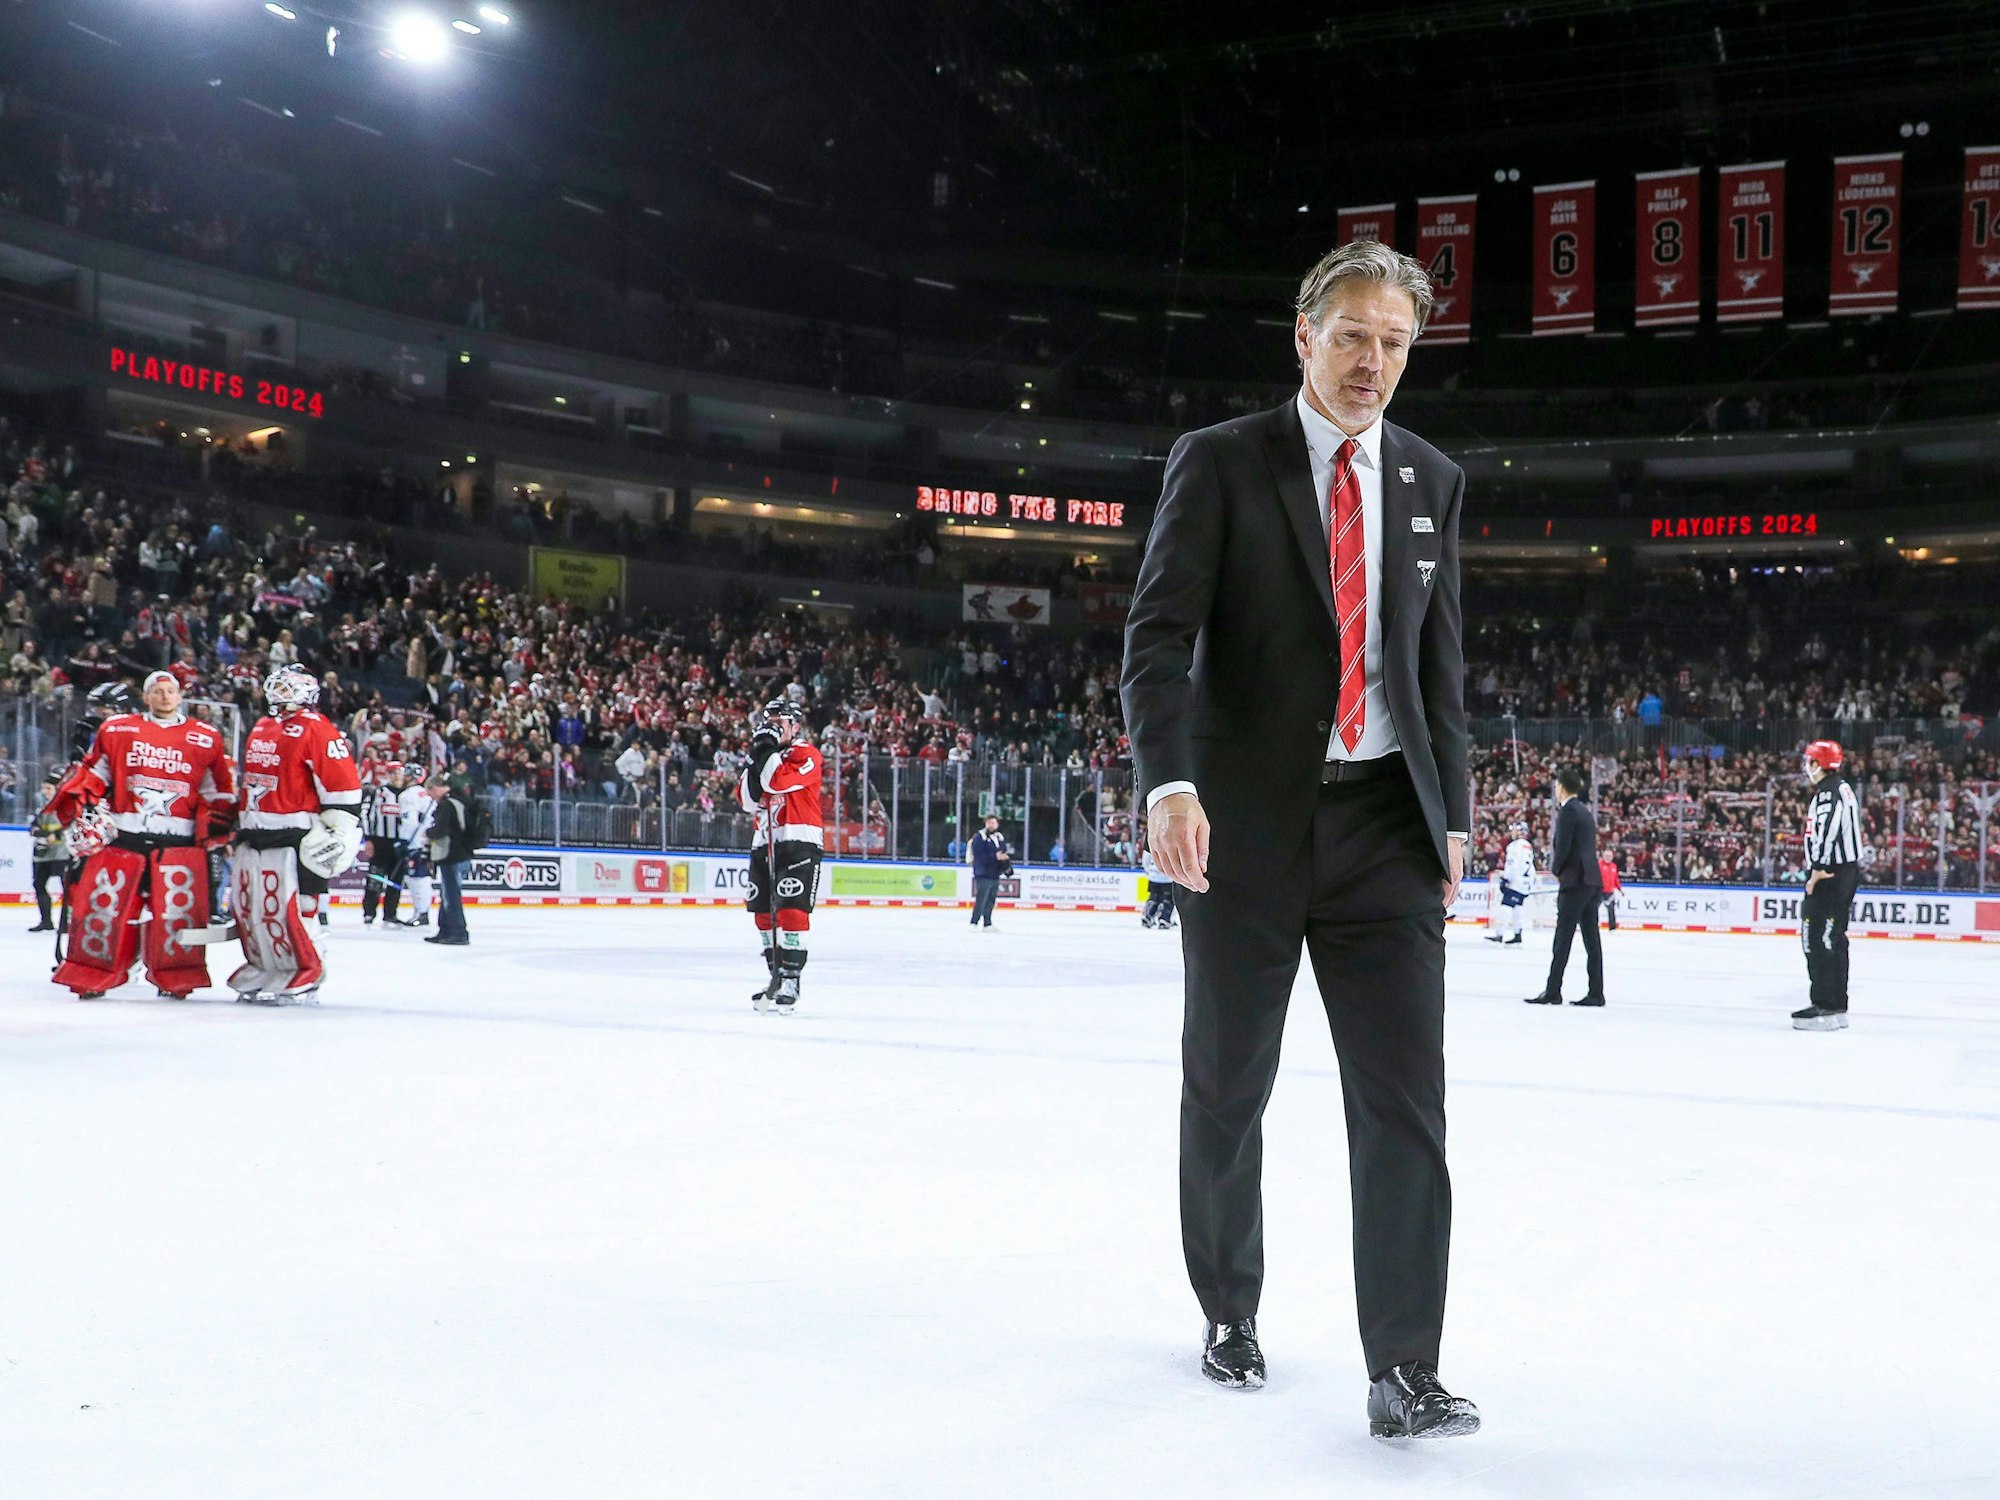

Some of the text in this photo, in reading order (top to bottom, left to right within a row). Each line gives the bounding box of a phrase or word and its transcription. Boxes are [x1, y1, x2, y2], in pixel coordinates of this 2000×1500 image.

[1652, 218, 1683, 265] 8
[1729, 211, 1774, 262] 11
[1840, 204, 1893, 255] 12
[1429, 243, 1457, 289] 4
[1551, 231, 1578, 278] 6
[110, 348, 324, 418] PLAYOFFS 2024
[916, 486, 1125, 527] BRING THE FIRE
[1651, 513, 1818, 538] PLAYOFFS 2024
[132, 741, 183, 761] Rhein
[327, 738, 350, 760] 45
[126, 752, 192, 774] Energie
[465, 862, 558, 883] MSPORTS
[641, 864, 663, 878] Time
[644, 877, 660, 888] out
[1030, 872, 1121, 886] erdmann@axis.de
[1763, 898, 1950, 925] SHAIE.DE
